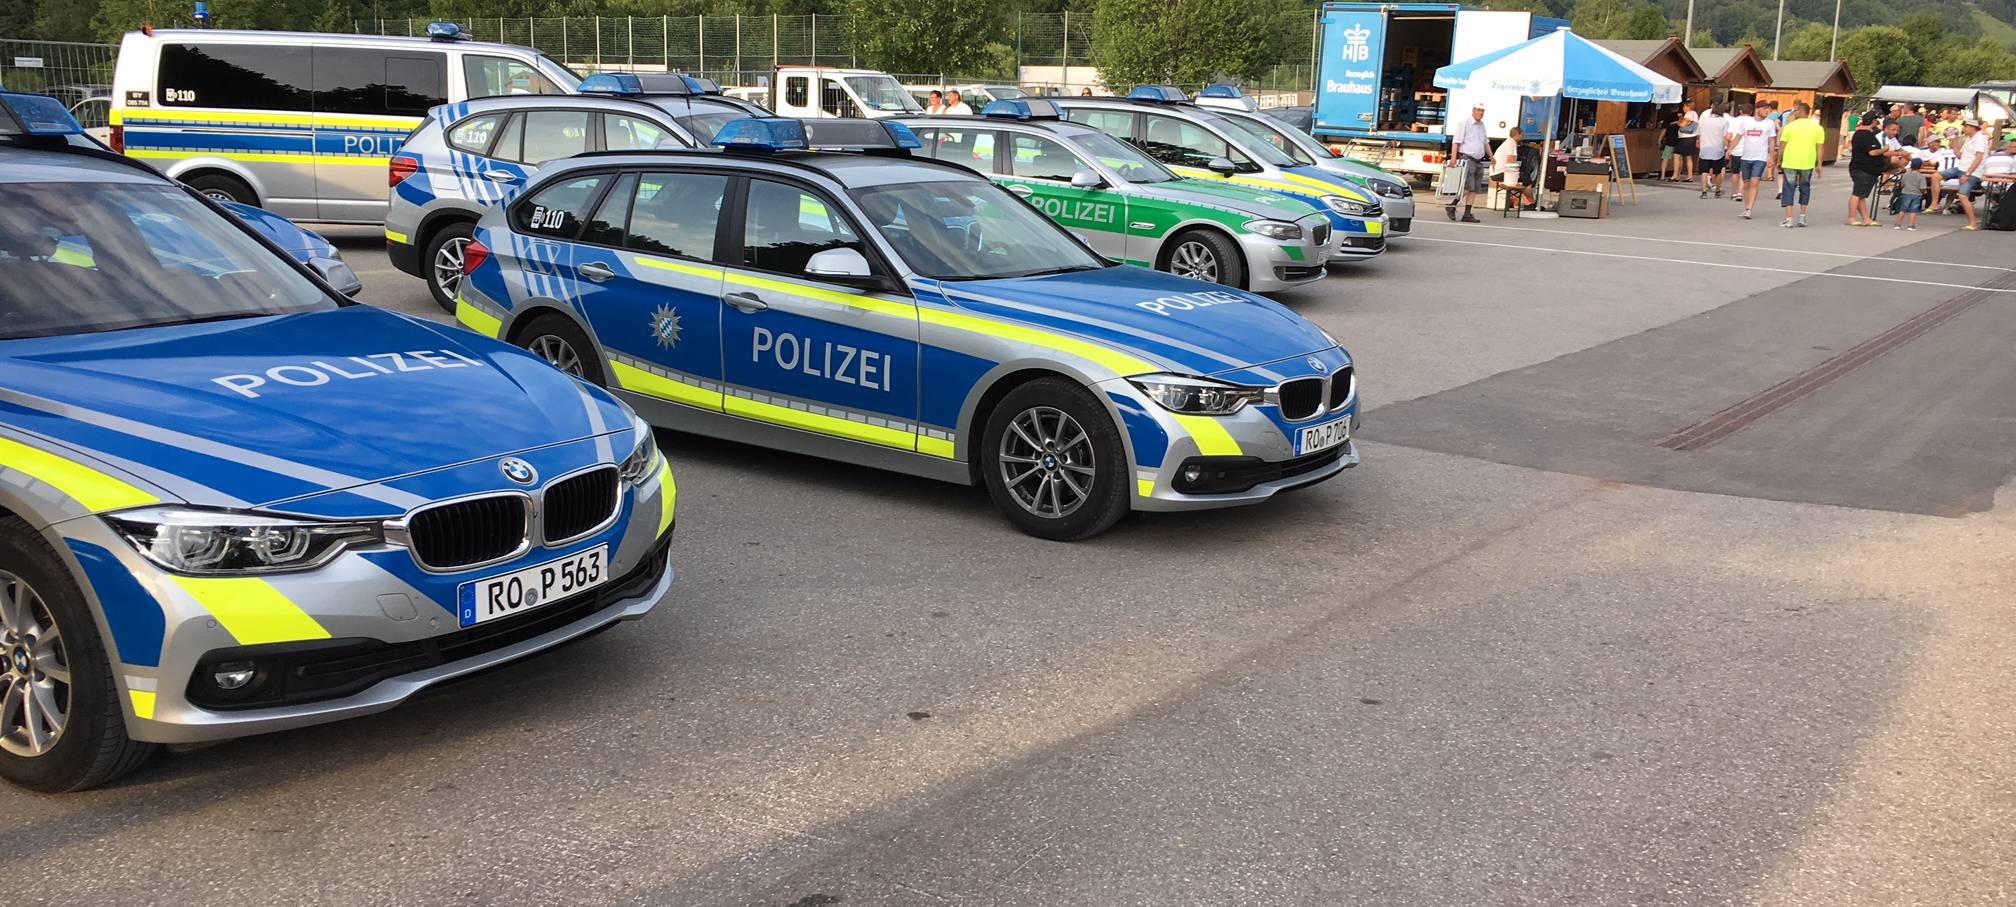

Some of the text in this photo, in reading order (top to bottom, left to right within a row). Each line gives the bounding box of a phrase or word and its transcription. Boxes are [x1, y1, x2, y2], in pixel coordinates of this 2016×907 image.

[177, 89, 196, 102] 110
[1327, 80, 1373, 94] Brauhaus
[467, 131, 487, 143] 110
[542, 209, 565, 229] 110
[1031, 196, 1115, 223] POLIZEI
[1135, 291, 1250, 316] POLIZEI
[752, 326, 891, 392] POLIZEI
[210, 349, 483, 399] POLIZEI
[1305, 428, 1320, 450] RO
[1326, 425, 1332, 445] P
[464, 551, 600, 619] D RO P 563
